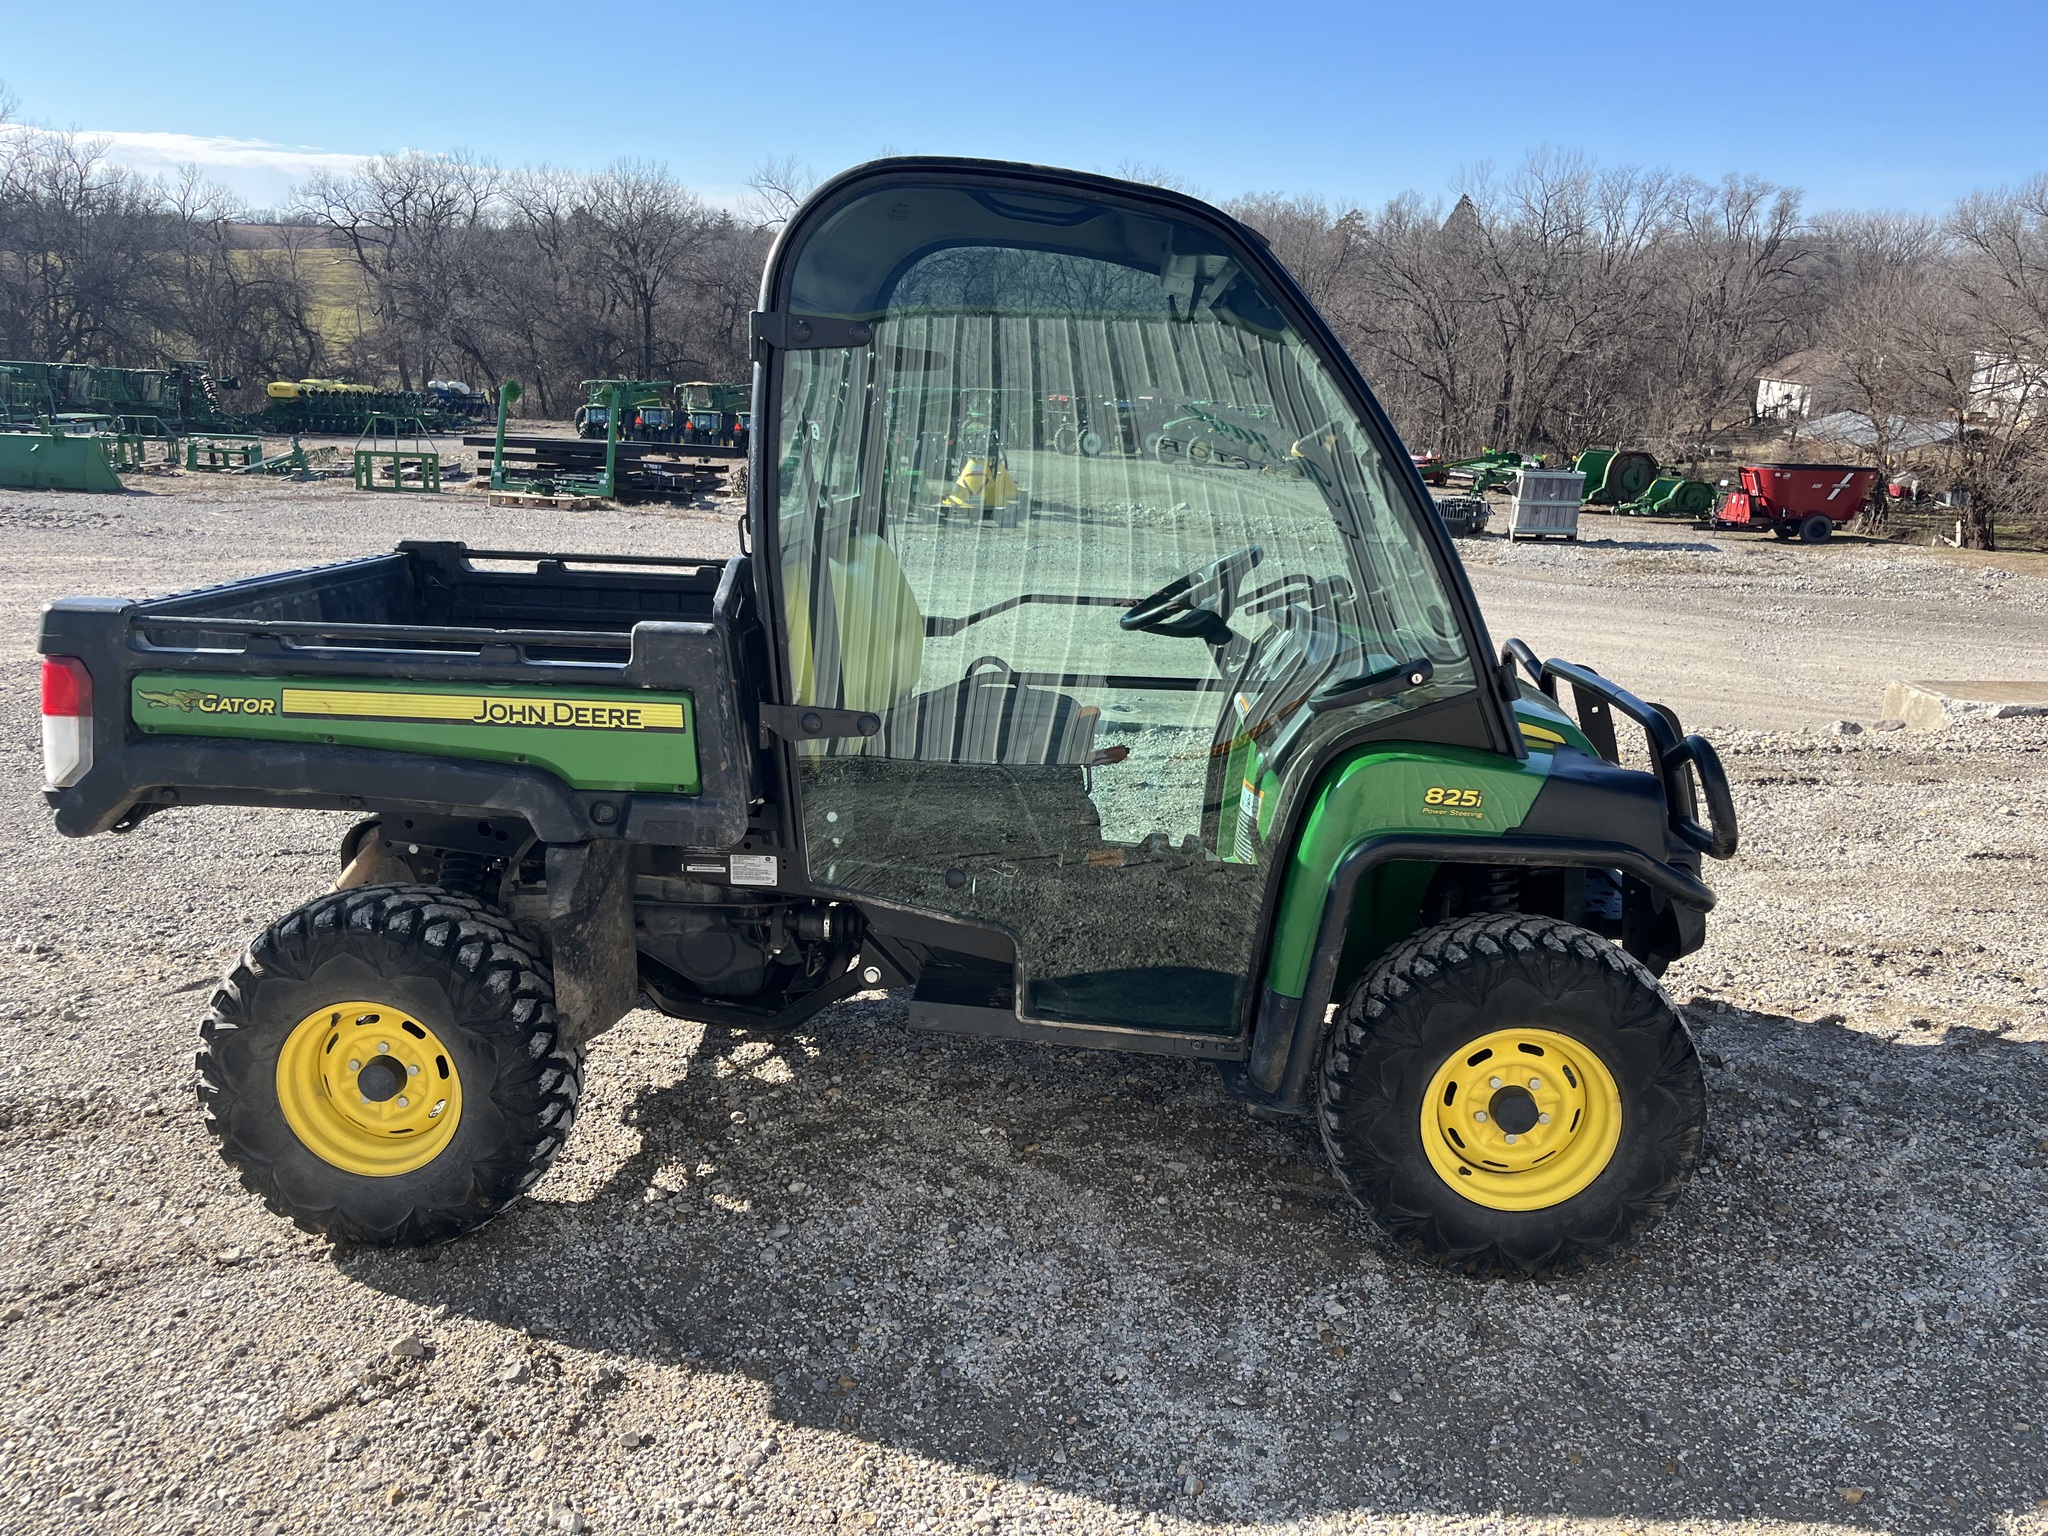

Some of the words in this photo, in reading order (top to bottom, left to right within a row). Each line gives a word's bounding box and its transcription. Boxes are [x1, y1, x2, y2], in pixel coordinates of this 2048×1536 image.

[198, 693, 276, 715] GATOR
[473, 699, 546, 724] JOHN
[553, 702, 643, 728] DEERE
[1424, 787, 1482, 808] 825i
[1422, 807, 1447, 815] Power
[1449, 809, 1483, 819] Steering
